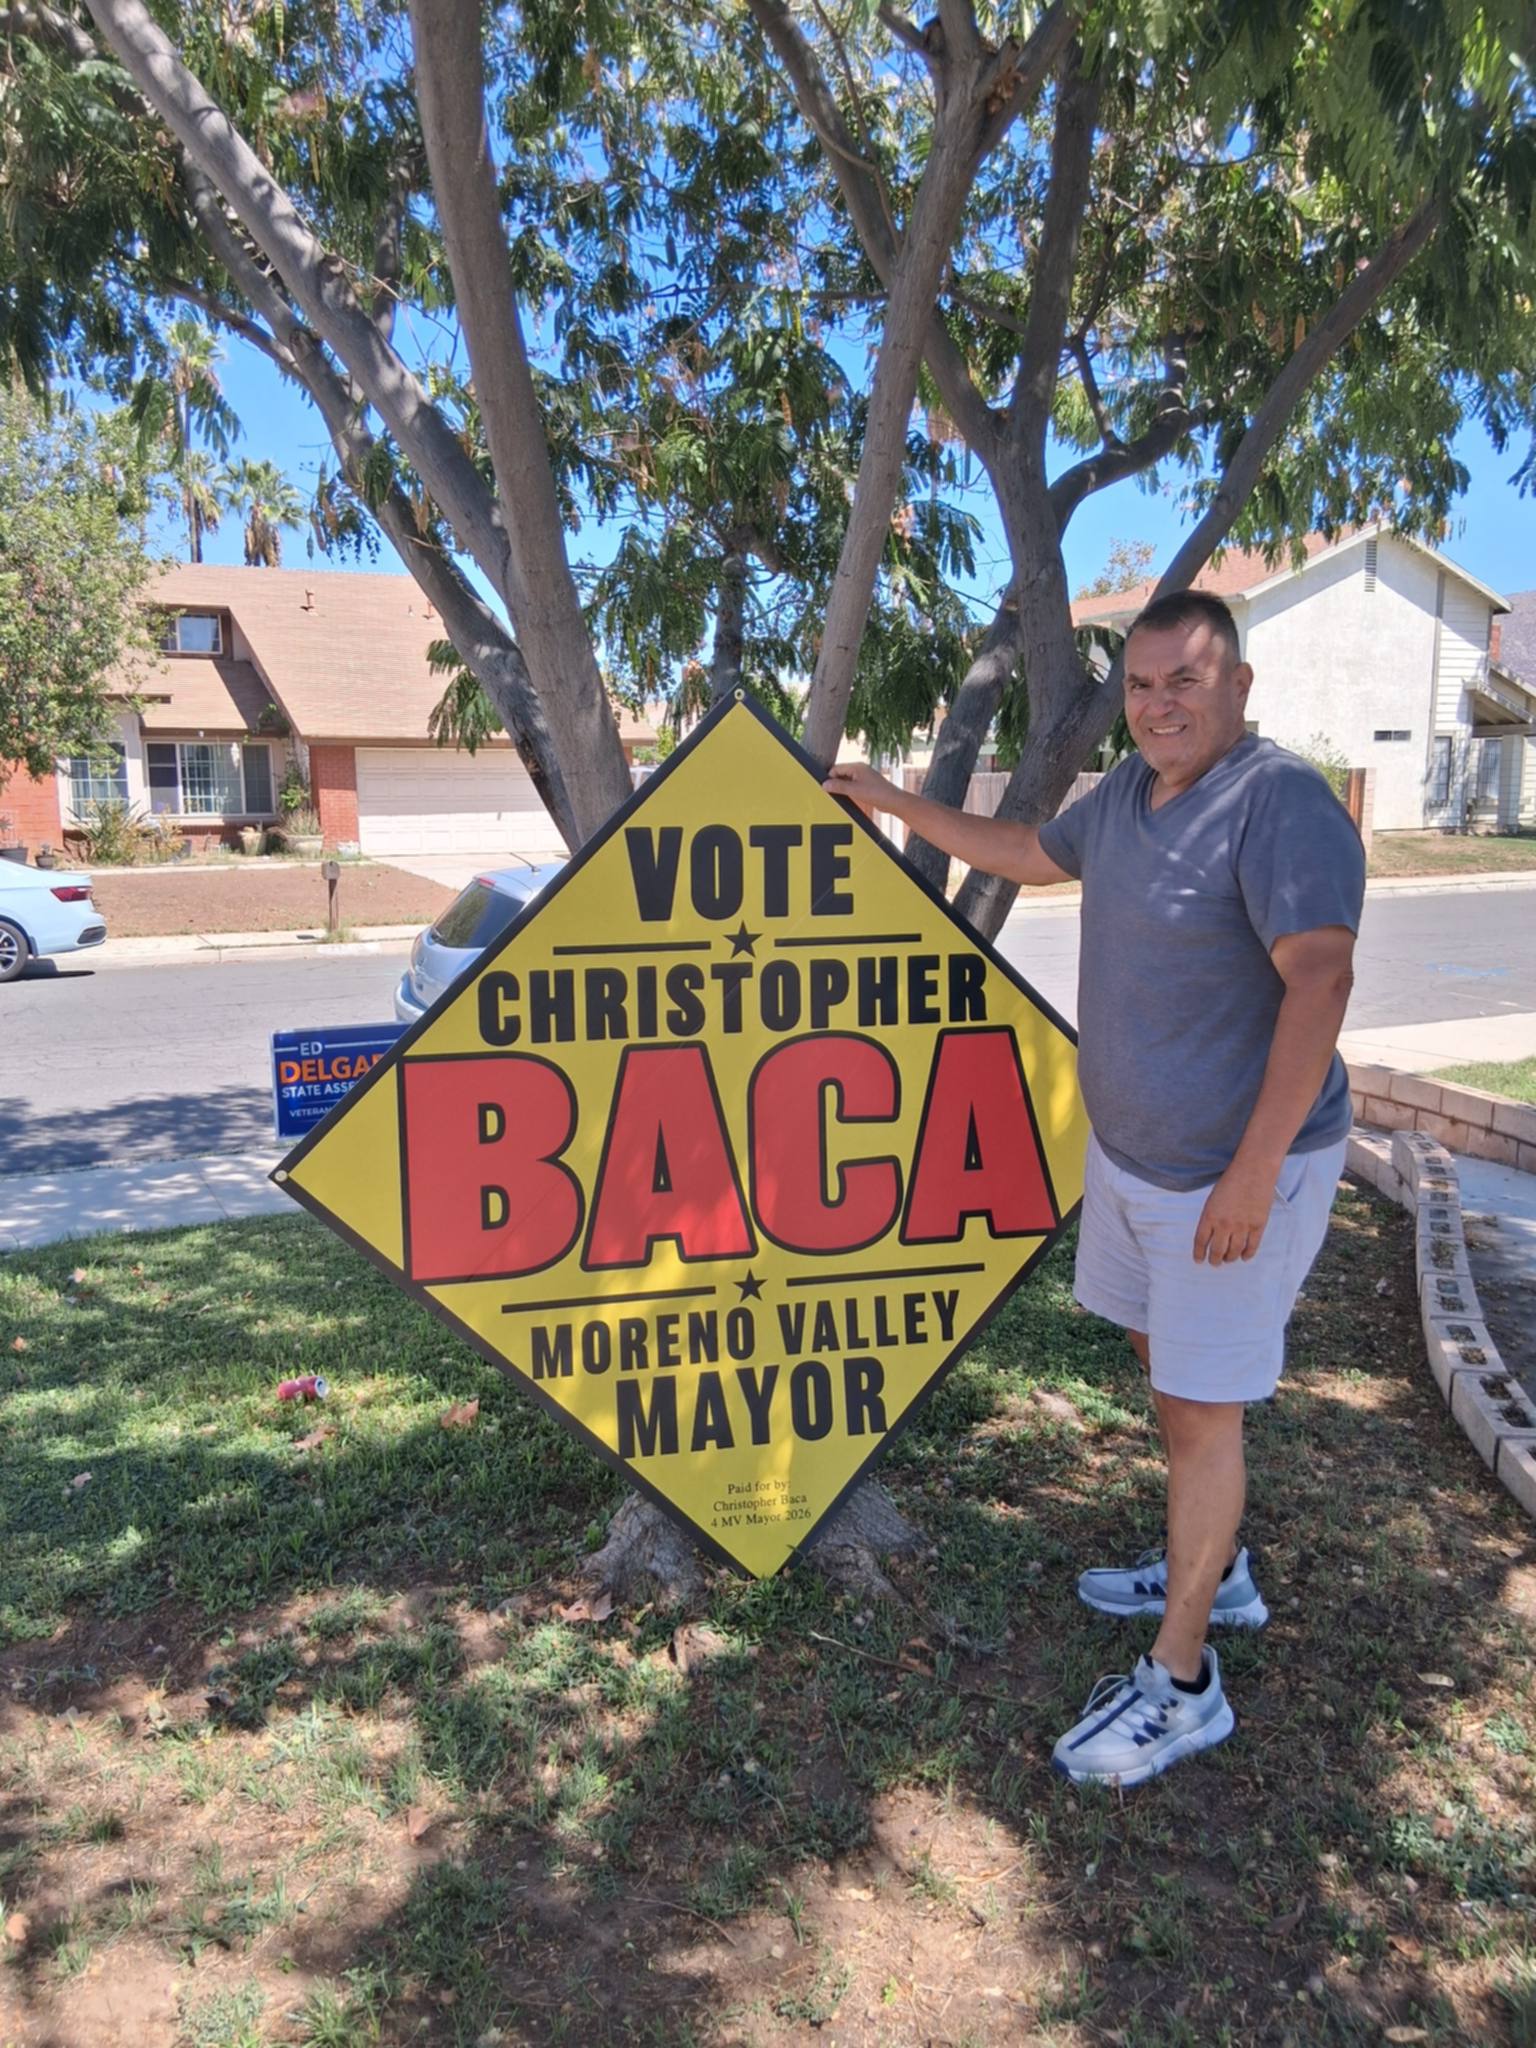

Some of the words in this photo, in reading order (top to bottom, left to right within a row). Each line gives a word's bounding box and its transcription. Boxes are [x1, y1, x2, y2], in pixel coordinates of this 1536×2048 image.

[624, 823, 854, 922] VOTE
[477, 953, 987, 1046] CHRISTOPHER
[300, 1041, 323, 1056] ED
[281, 1085, 321, 1099] STATE
[402, 1027, 1059, 1281] BACA
[531, 1306, 756, 1379] MORENO
[776, 1289, 960, 1355] VALLEY
[616, 1356, 889, 1459] MAYOR
[713, 1497, 778, 1512] Christopher
[781, 1494, 808, 1505] Baca
[728, 1482, 752, 1494] Paid
[755, 1481, 771, 1491] for
[711, 1518, 718, 1527] 4
[721, 1515, 742, 1527] MV
[746, 1513, 781, 1525] Mayor
[785, 1508, 811, 1520] 2026
